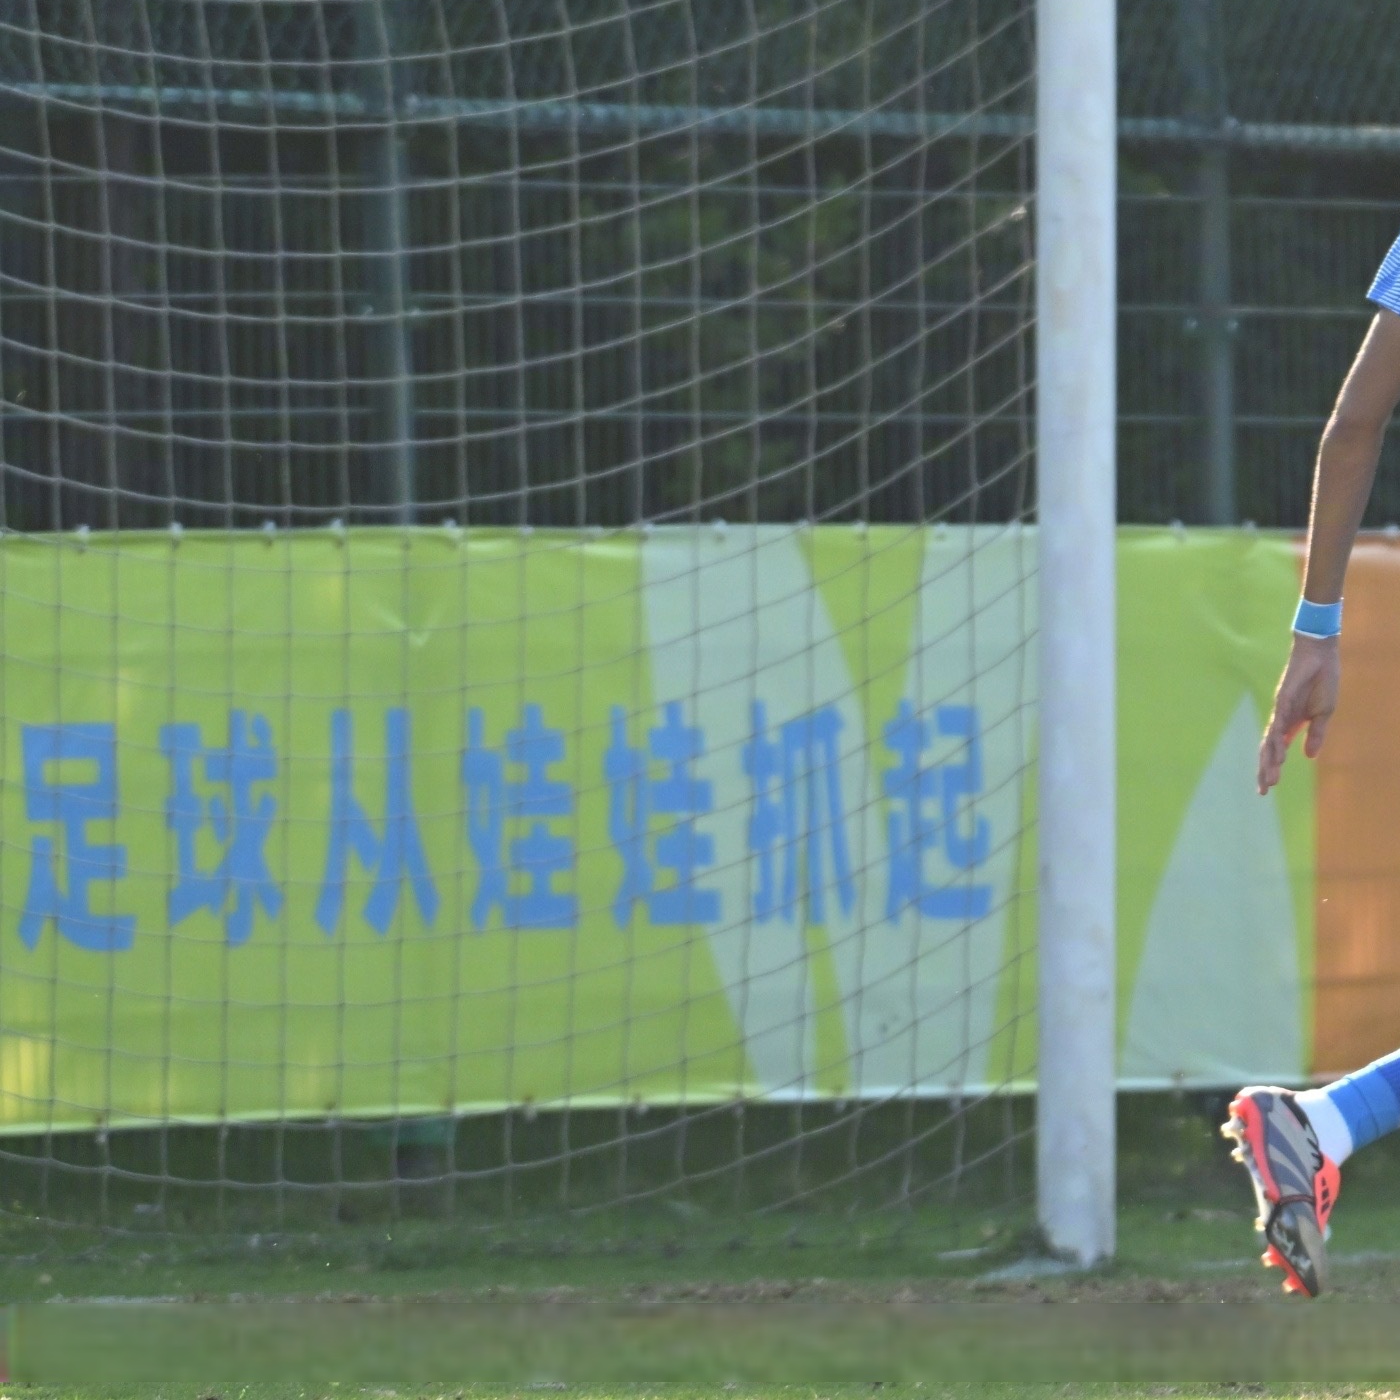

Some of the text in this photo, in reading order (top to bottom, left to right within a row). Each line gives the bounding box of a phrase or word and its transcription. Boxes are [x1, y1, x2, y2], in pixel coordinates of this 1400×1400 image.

[17, 698, 993, 953] 足球从娃娃抓起
